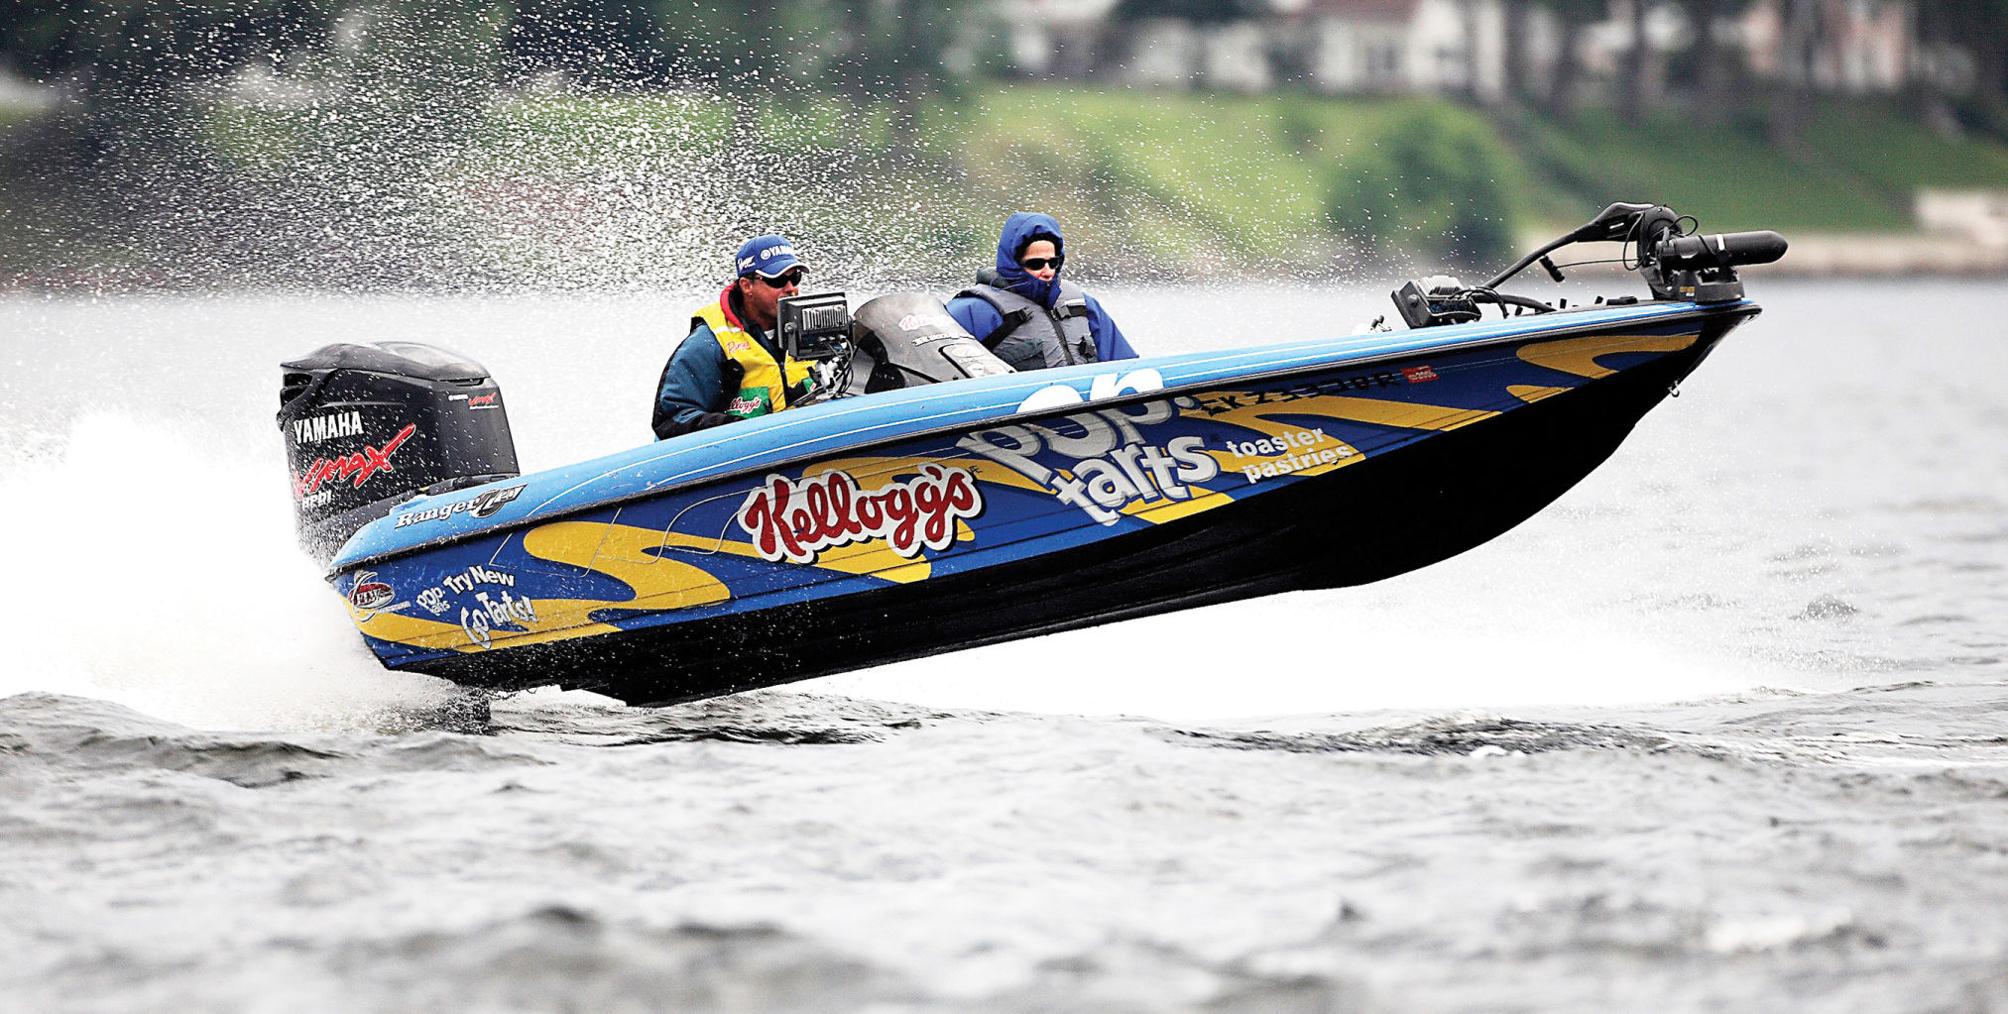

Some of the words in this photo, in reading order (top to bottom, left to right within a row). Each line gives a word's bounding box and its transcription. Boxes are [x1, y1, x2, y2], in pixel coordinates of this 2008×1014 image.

[294, 411, 364, 443] YAMAHA
[1225, 427, 1324, 459] toaster
[1241, 444, 1354, 484] pastries
[394, 493, 481, 529] Ranger
[737, 462, 983, 564] Kellogg's
[443, 572, 473, 595] Try
[469, 565, 515, 587] New
